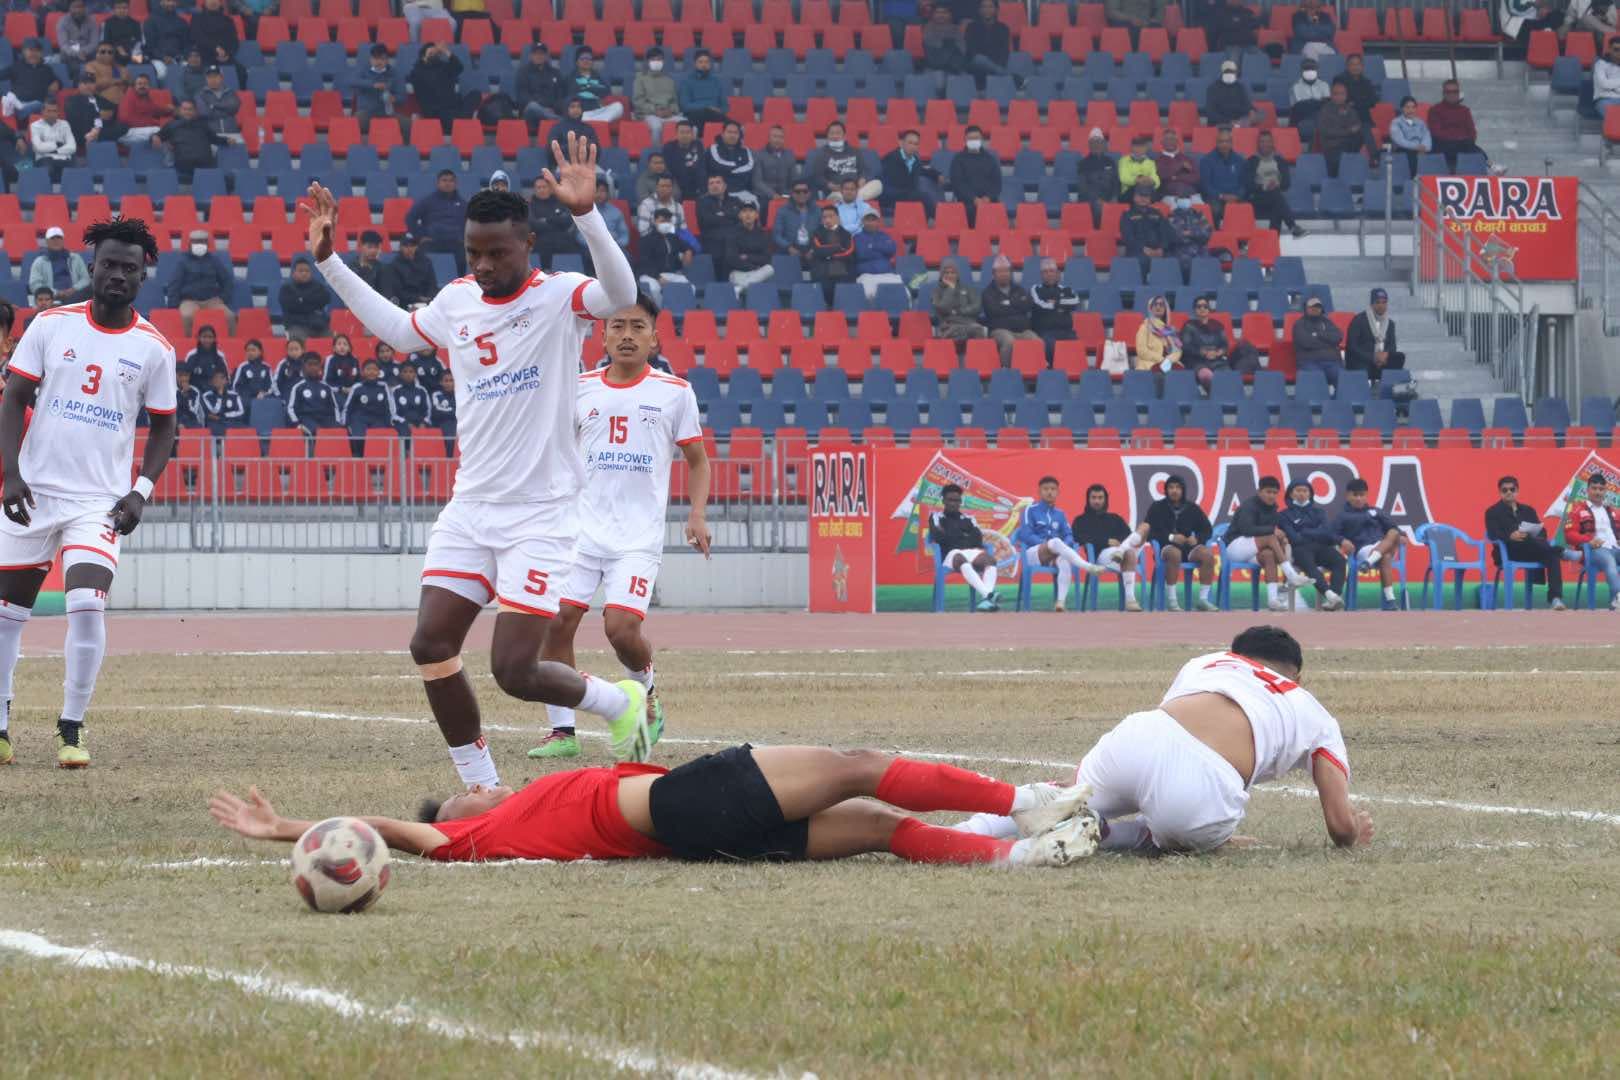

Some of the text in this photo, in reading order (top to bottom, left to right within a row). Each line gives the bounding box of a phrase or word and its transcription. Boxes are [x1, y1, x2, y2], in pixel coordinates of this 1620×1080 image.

[1436, 177, 1561, 219] RARA
[474, 332, 498, 367] 5
[81, 364, 103, 395] 3
[492, 365, 540, 387] POWER
[63, 411, 98, 425] COMPANY
[65, 399, 124, 423] API POWER
[608, 415, 628, 444] 15
[598, 451, 653, 465] API POWER
[811, 452, 870, 517] RARA
[524, 568, 549, 596] 5
[629, 575, 648, 598] 15
